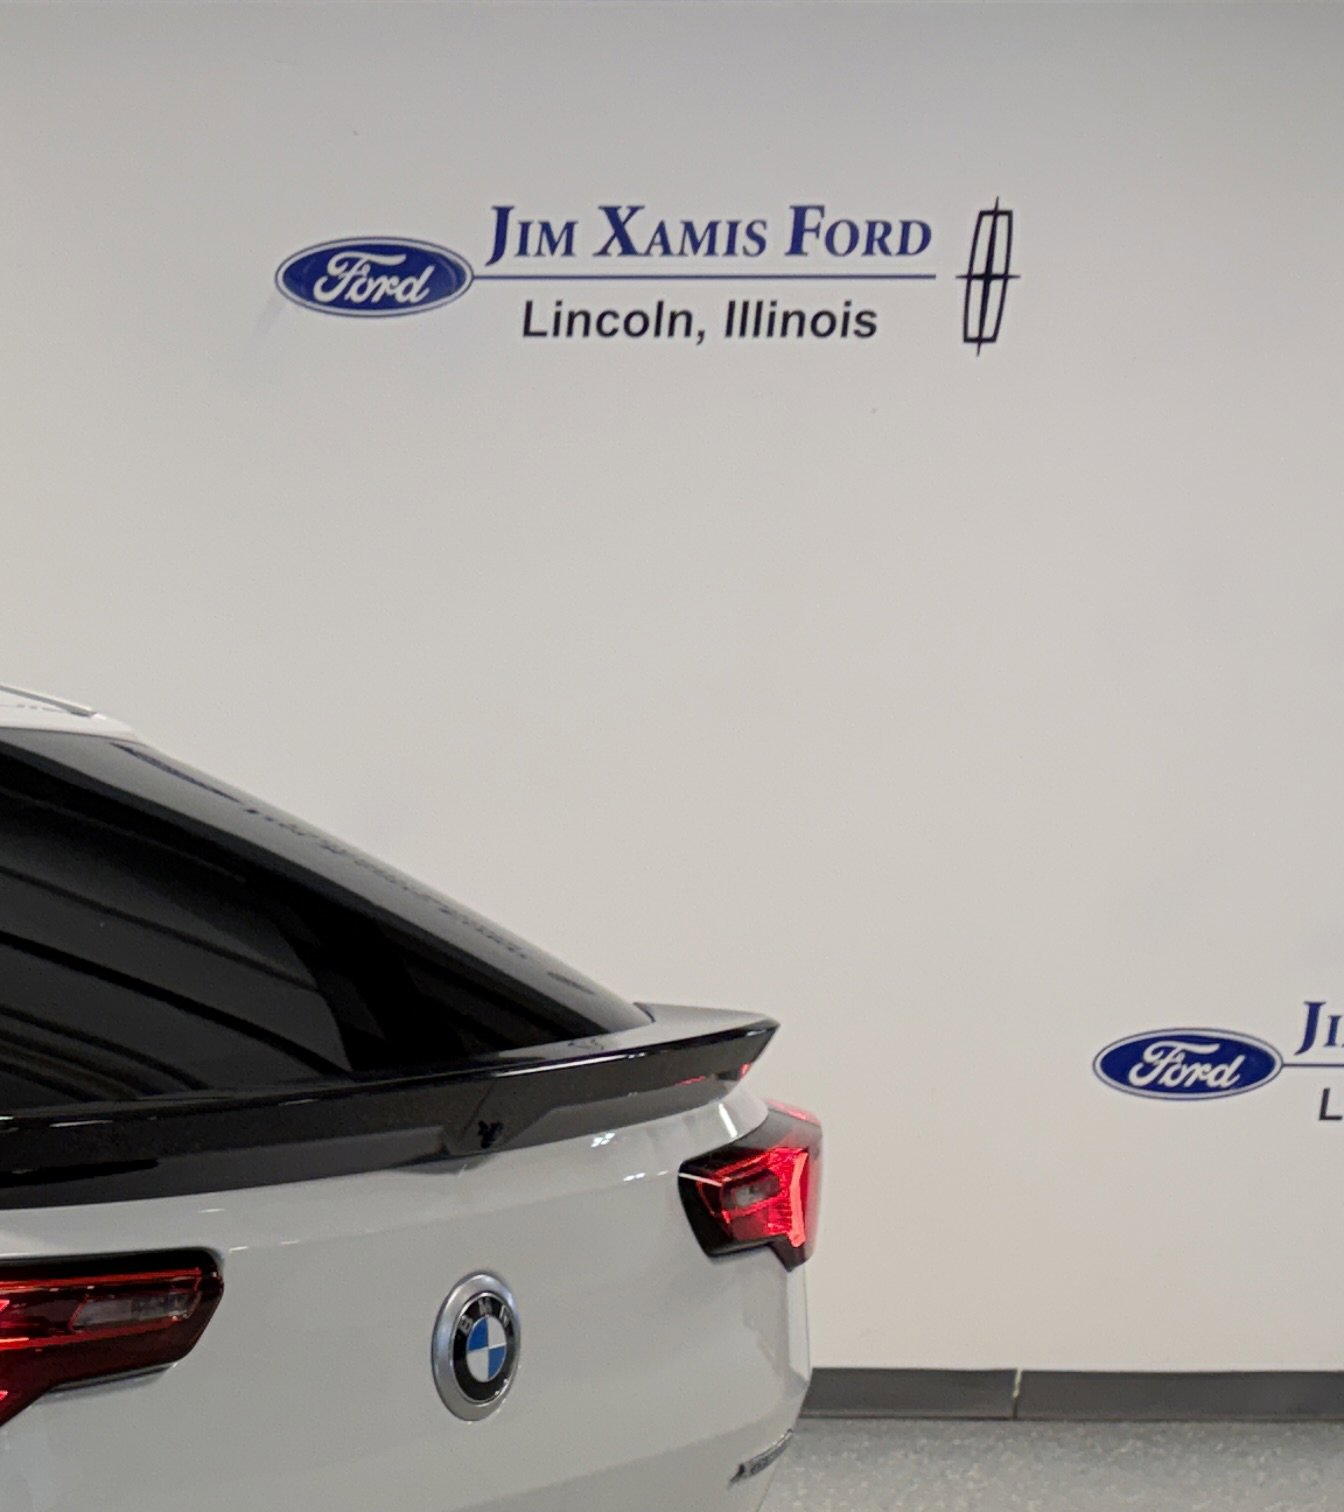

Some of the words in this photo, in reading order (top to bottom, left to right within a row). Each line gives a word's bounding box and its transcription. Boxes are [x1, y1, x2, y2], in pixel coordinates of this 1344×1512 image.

[484, 204, 579, 267] JIM
[592, 204, 768, 258] XAMIS
[784, 204, 933, 258] FORD
[311, 251, 436, 304] Ford
[522, 299, 707, 346] Lincoln,
[724, 299, 878, 339] Illinois
[1294, 1000, 1344, 1056] JI
[1127, 1039, 1246, 1089] Ford
